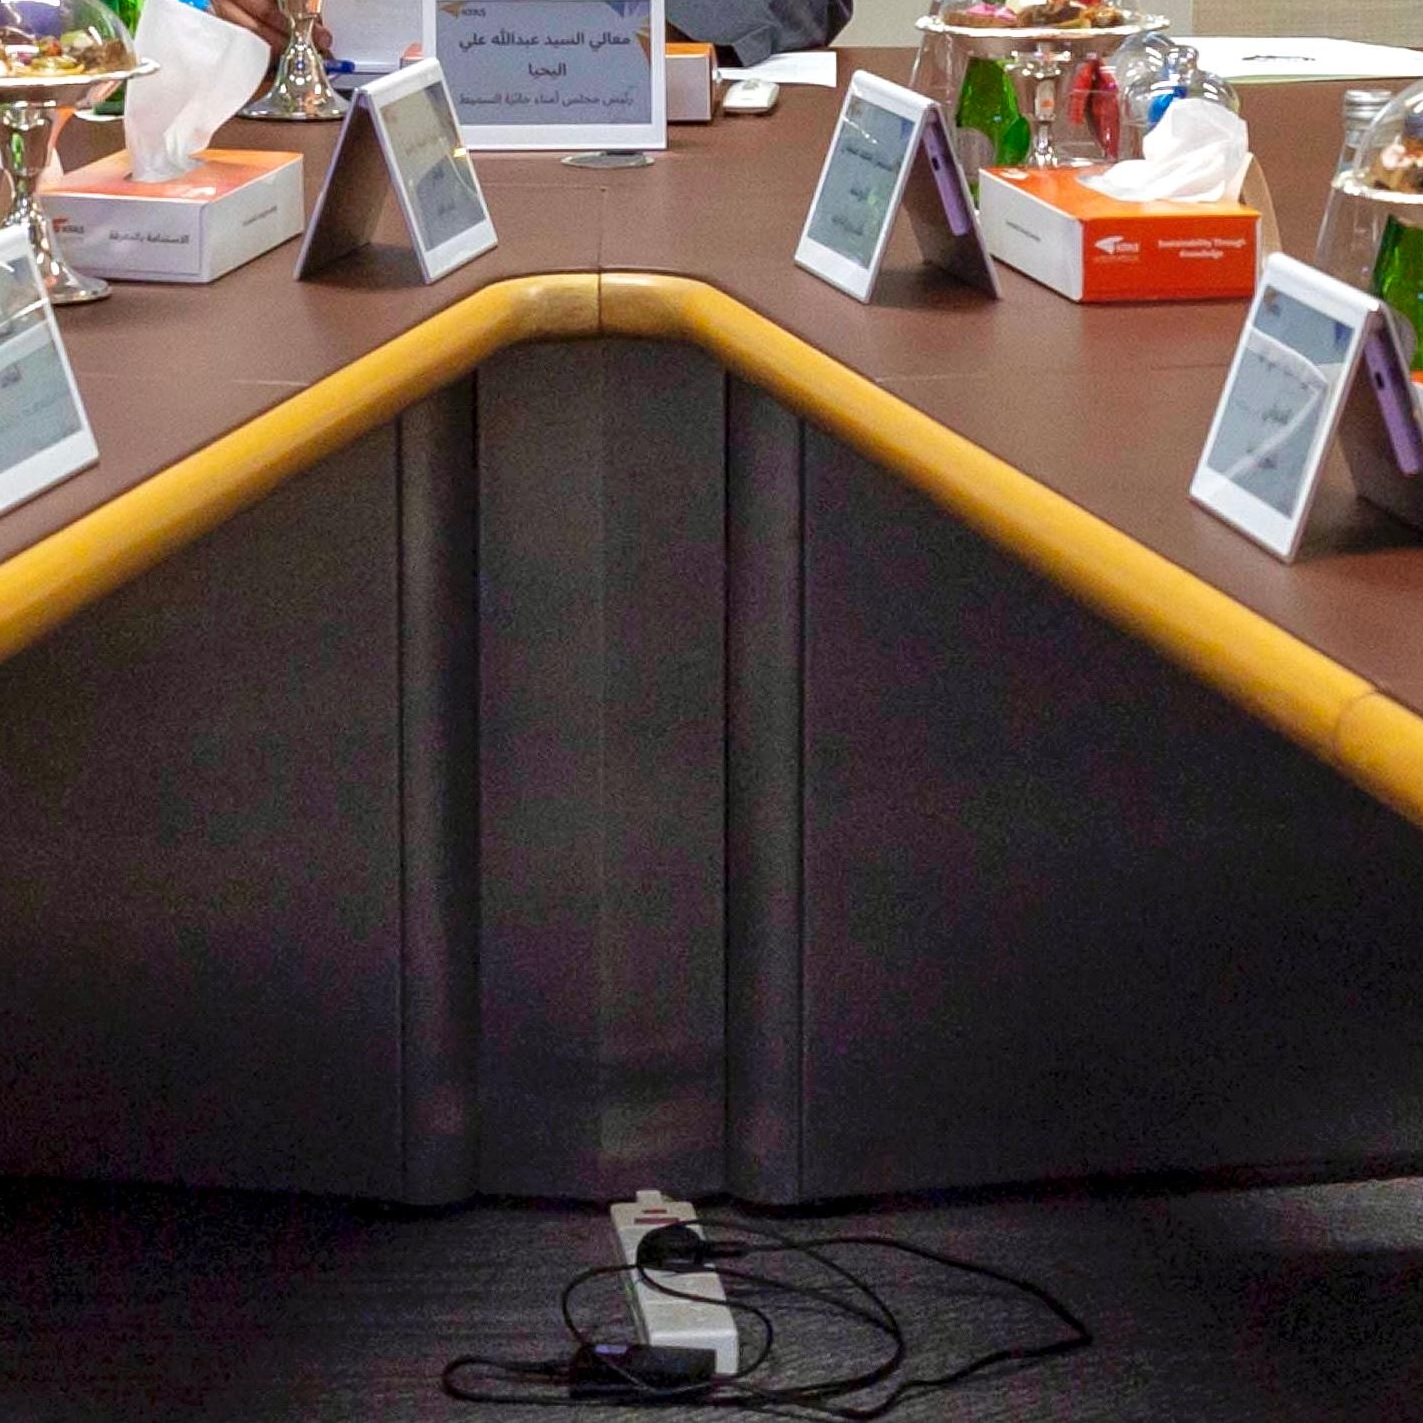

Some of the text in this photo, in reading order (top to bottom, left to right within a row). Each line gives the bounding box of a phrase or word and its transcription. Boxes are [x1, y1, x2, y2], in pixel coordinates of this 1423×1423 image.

[459, 28, 631, 52] معالي السيد عبدالله علي
